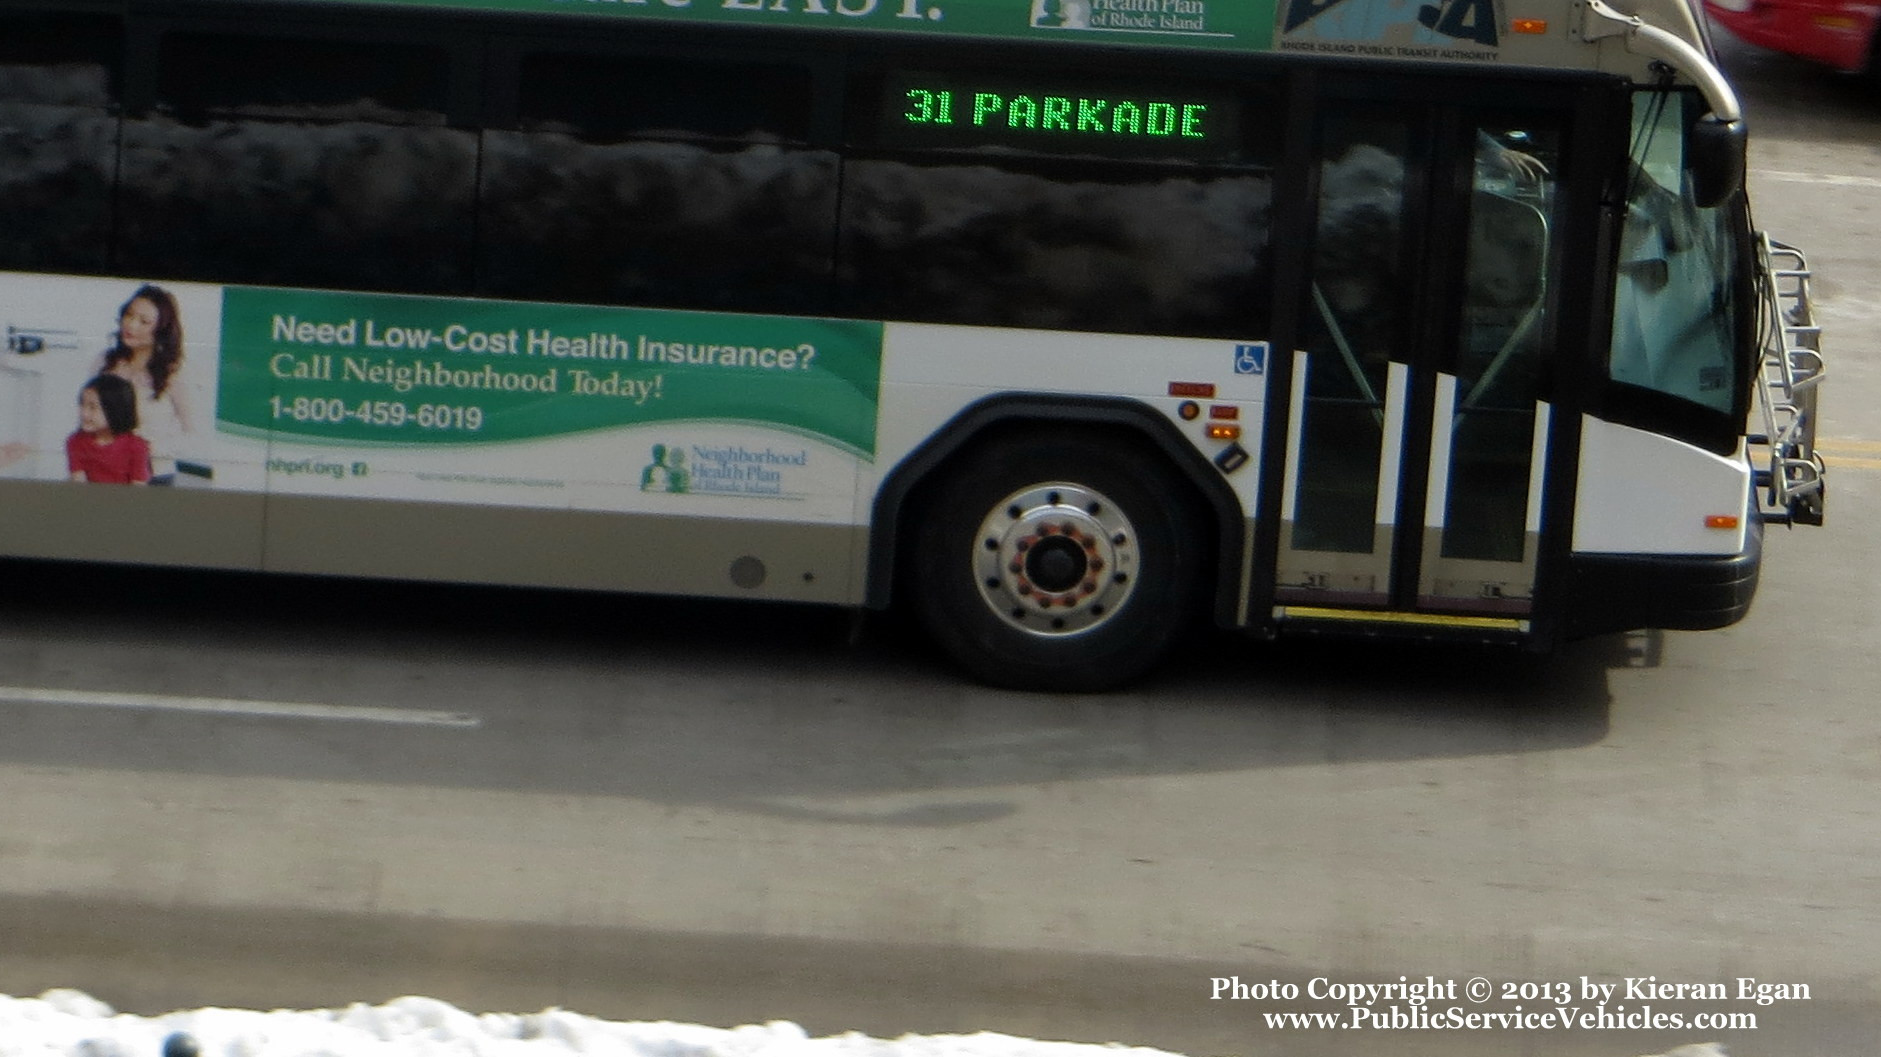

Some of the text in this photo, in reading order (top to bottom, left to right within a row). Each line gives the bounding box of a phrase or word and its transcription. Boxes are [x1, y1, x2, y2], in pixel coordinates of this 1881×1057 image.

[1090, 12, 1204, 31] of Rhode Island
[1281, 41, 1499, 62] RHODE ISLAND PUBLIC TRANSIT AUTHORITY
[904, 89, 1208, 138] 31 PARKADE
[271, 314, 816, 371] Need Low-Cost Health Insurance?
[269, 353, 665, 406] Call Neighborhood Today!
[269, 395, 483, 431] 1-800-459-6019
[692, 444, 808, 466] Neighborhood
[691, 462, 781, 482] Health Plan
